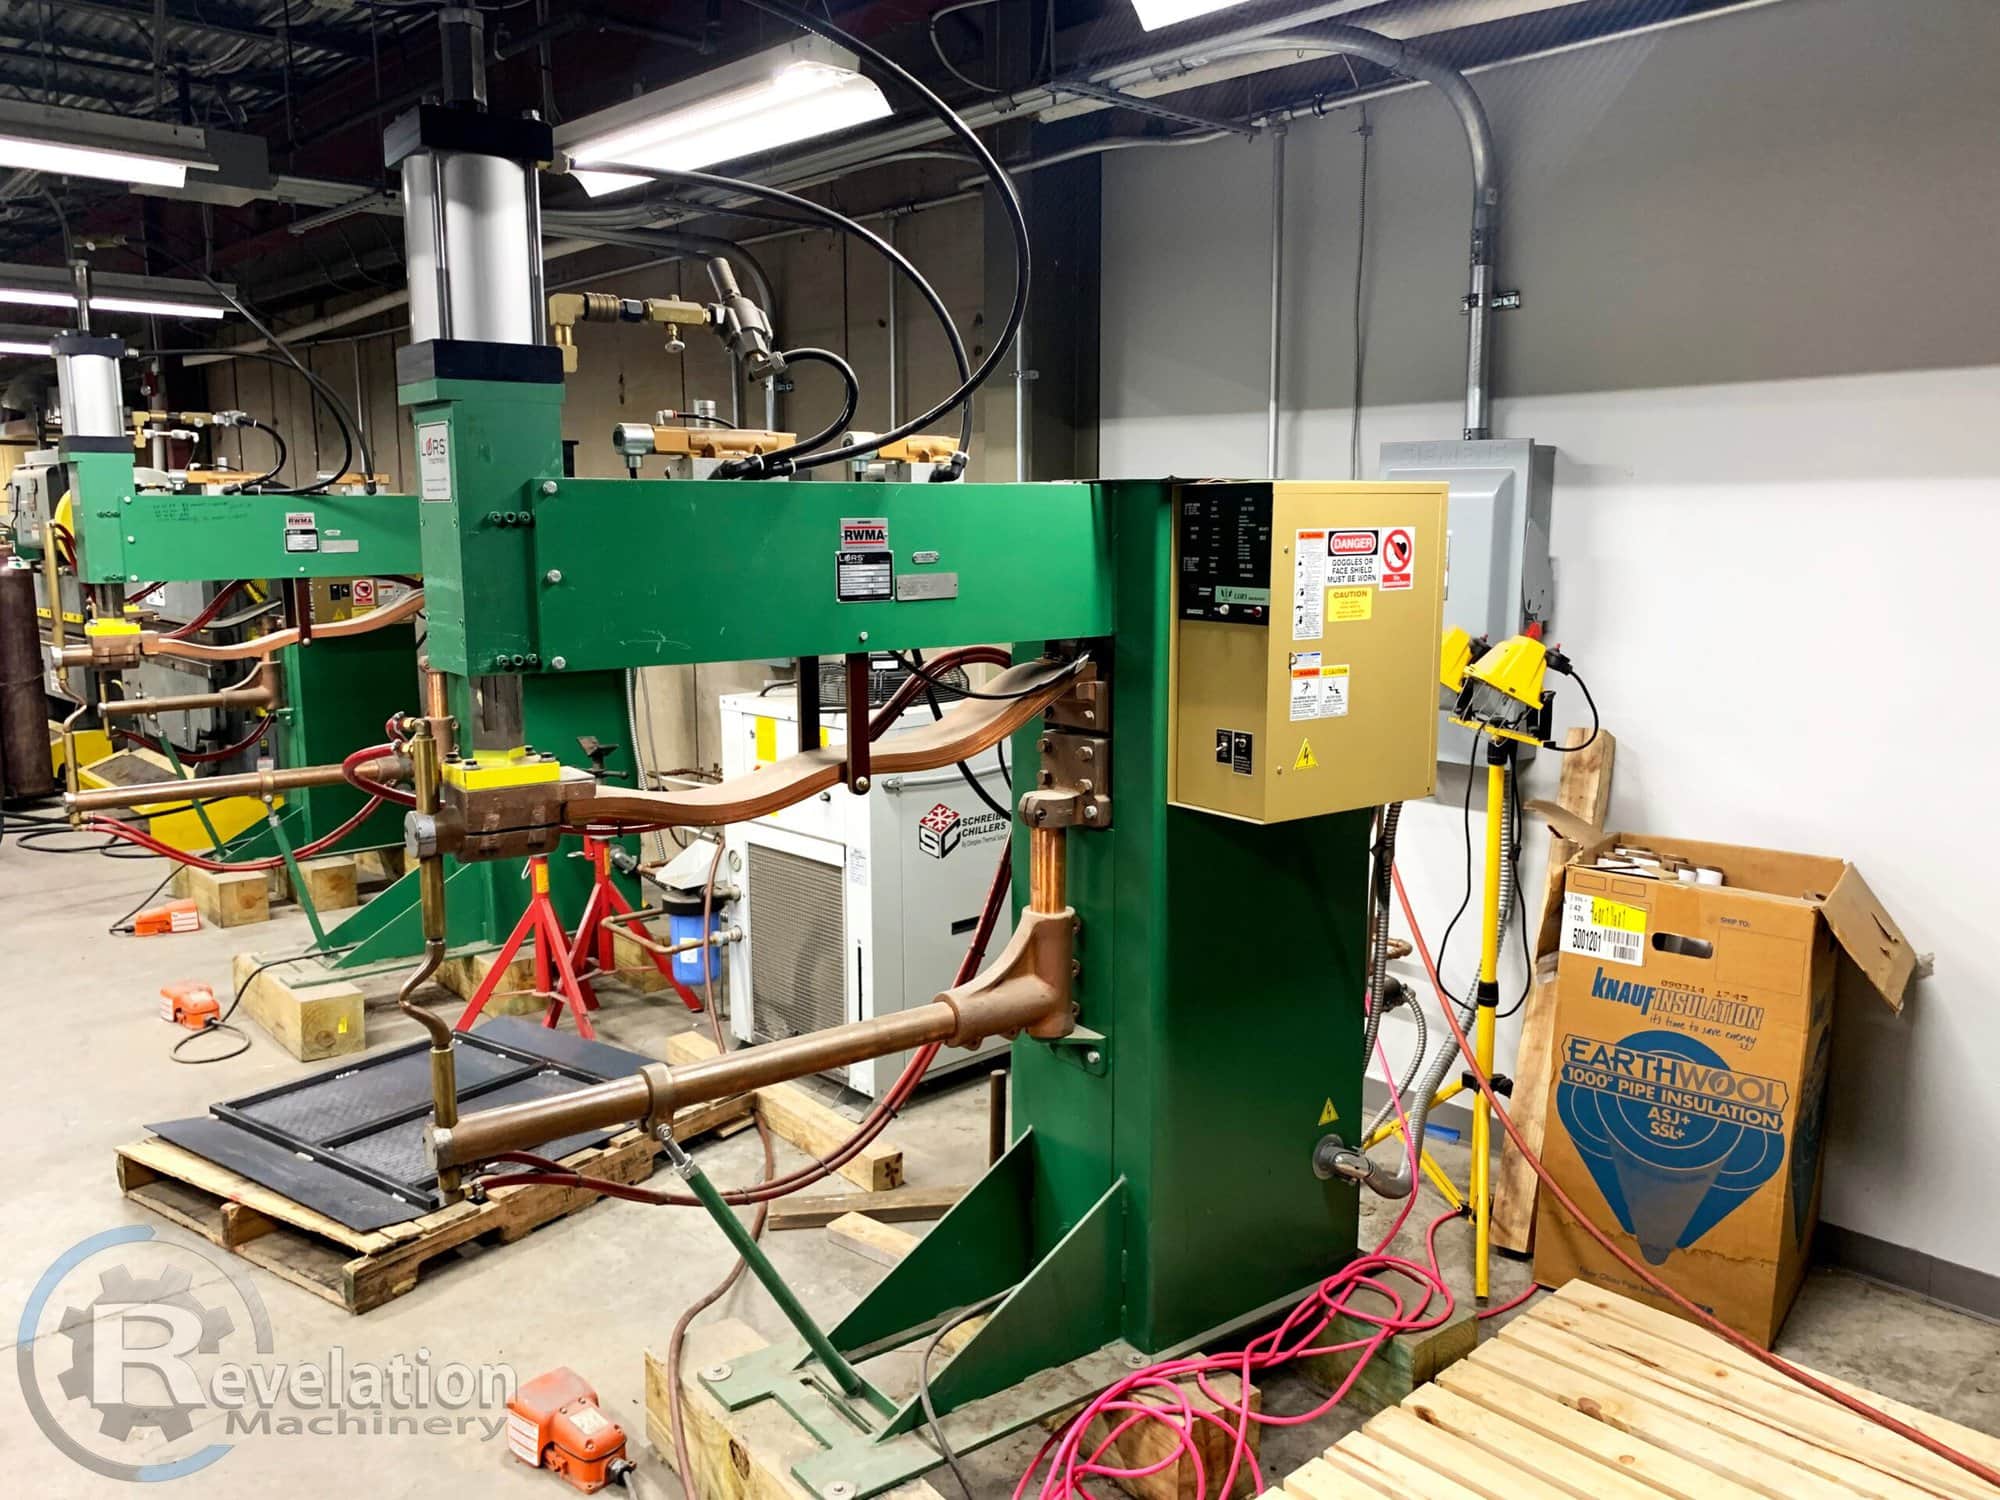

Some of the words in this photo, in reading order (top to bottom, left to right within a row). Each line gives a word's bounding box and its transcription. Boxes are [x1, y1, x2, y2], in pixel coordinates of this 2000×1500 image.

[844, 529, 885, 541] RWMA
[1333, 538, 1373, 550] DANGER
[1332, 558, 1363, 567] GOGGLES
[1365, 557, 1373, 566] OR
[1332, 567, 1348, 575] FACE
[1350, 566, 1372, 574] SHIELD
[1347, 575, 1355, 583] BE
[1357, 574, 1377, 582] WORN
[1333, 590, 1368, 599] CAUTION
[961, 821, 1007, 838] CHILLERS
[1572, 927, 1601, 952] 5001201
[1652, 987, 1766, 1031] INSULATION
[1702, 1027, 1721, 1038] save
[1725, 1032, 1757, 1051] energy
[1618, 1078, 1656, 1101] PIPE
[1661, 1089, 1780, 1130] INSULATION
[1647, 1106, 1692, 1126] ASJ+
[1649, 1122, 1686, 1140] SSL+
